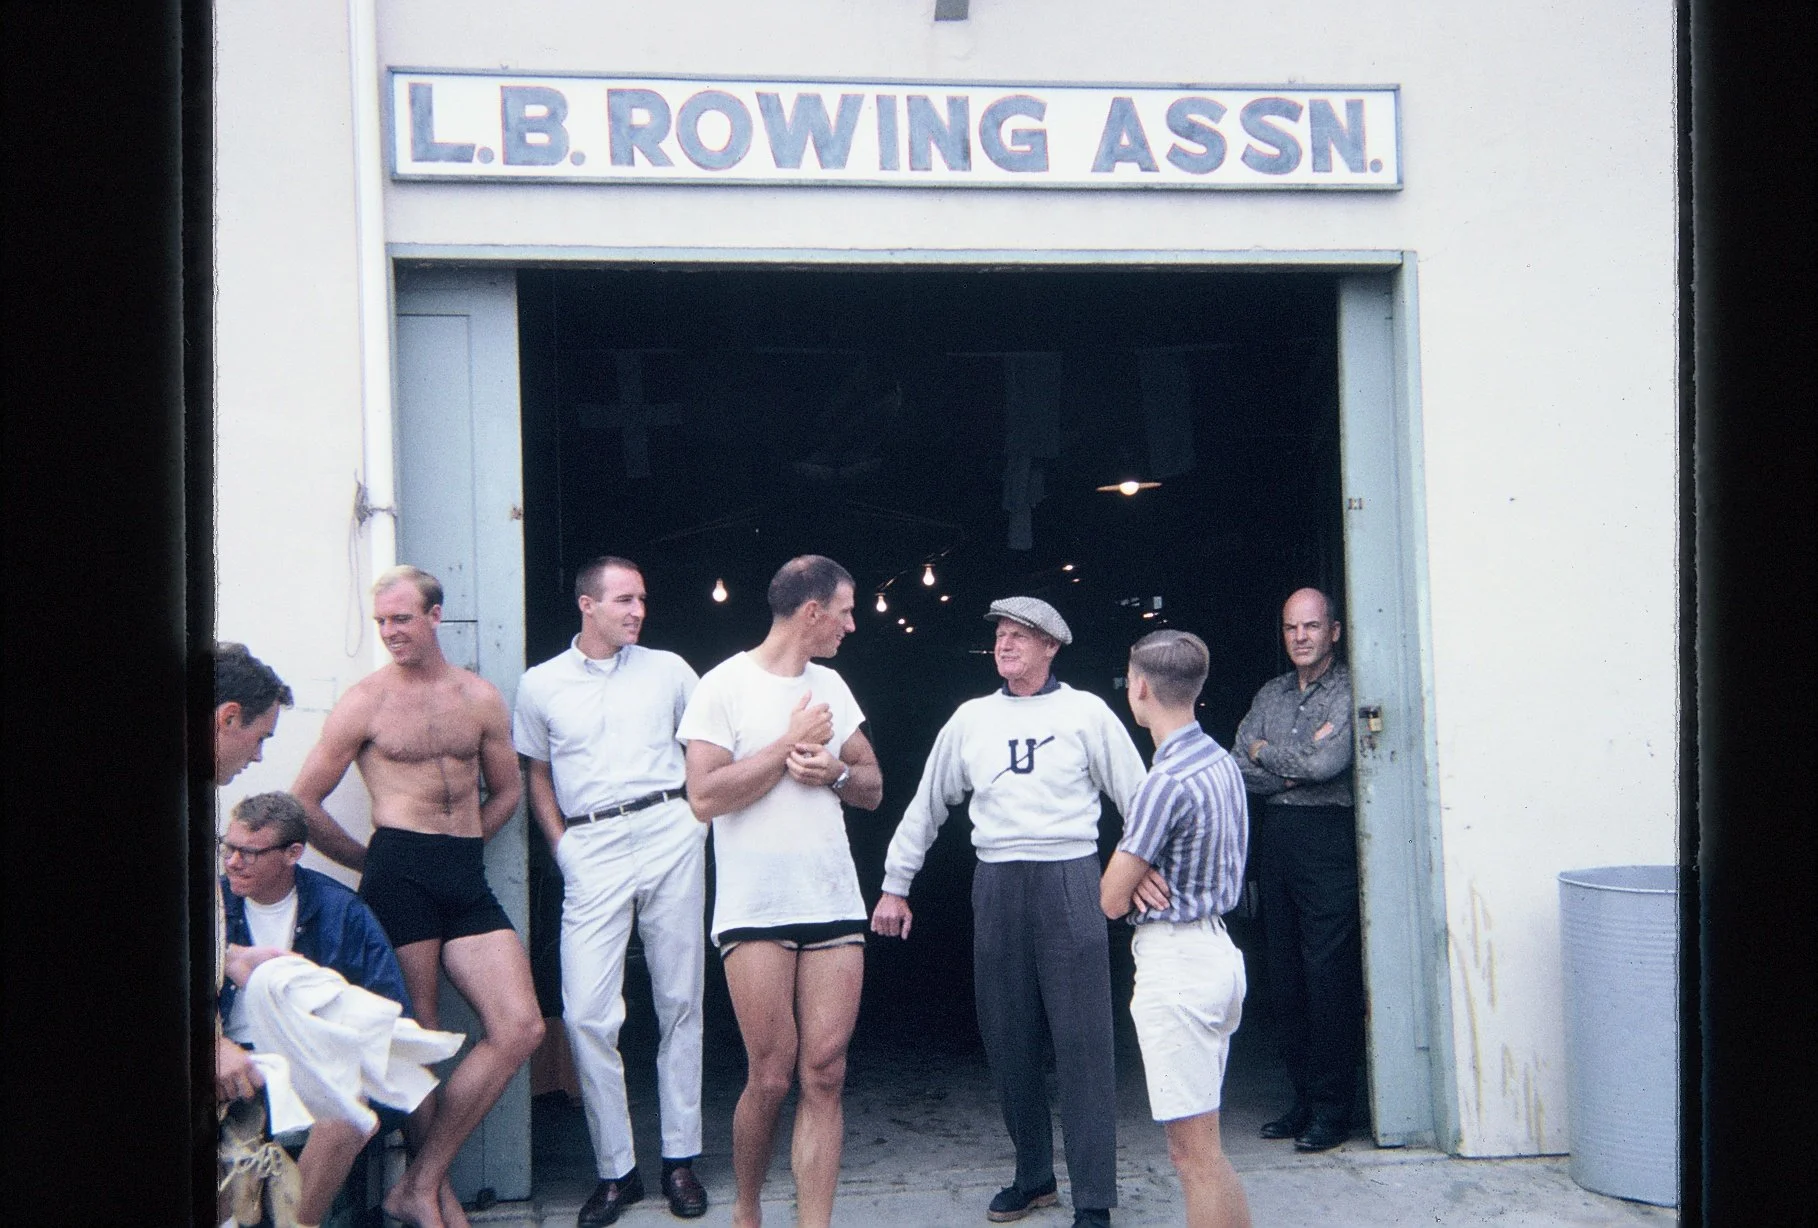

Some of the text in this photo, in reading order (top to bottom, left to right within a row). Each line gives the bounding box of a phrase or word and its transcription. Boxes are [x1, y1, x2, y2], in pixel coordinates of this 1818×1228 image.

[408, 82, 1383, 175] L.B. ROWING ASSN.
[1008, 738, 1036, 774] U
